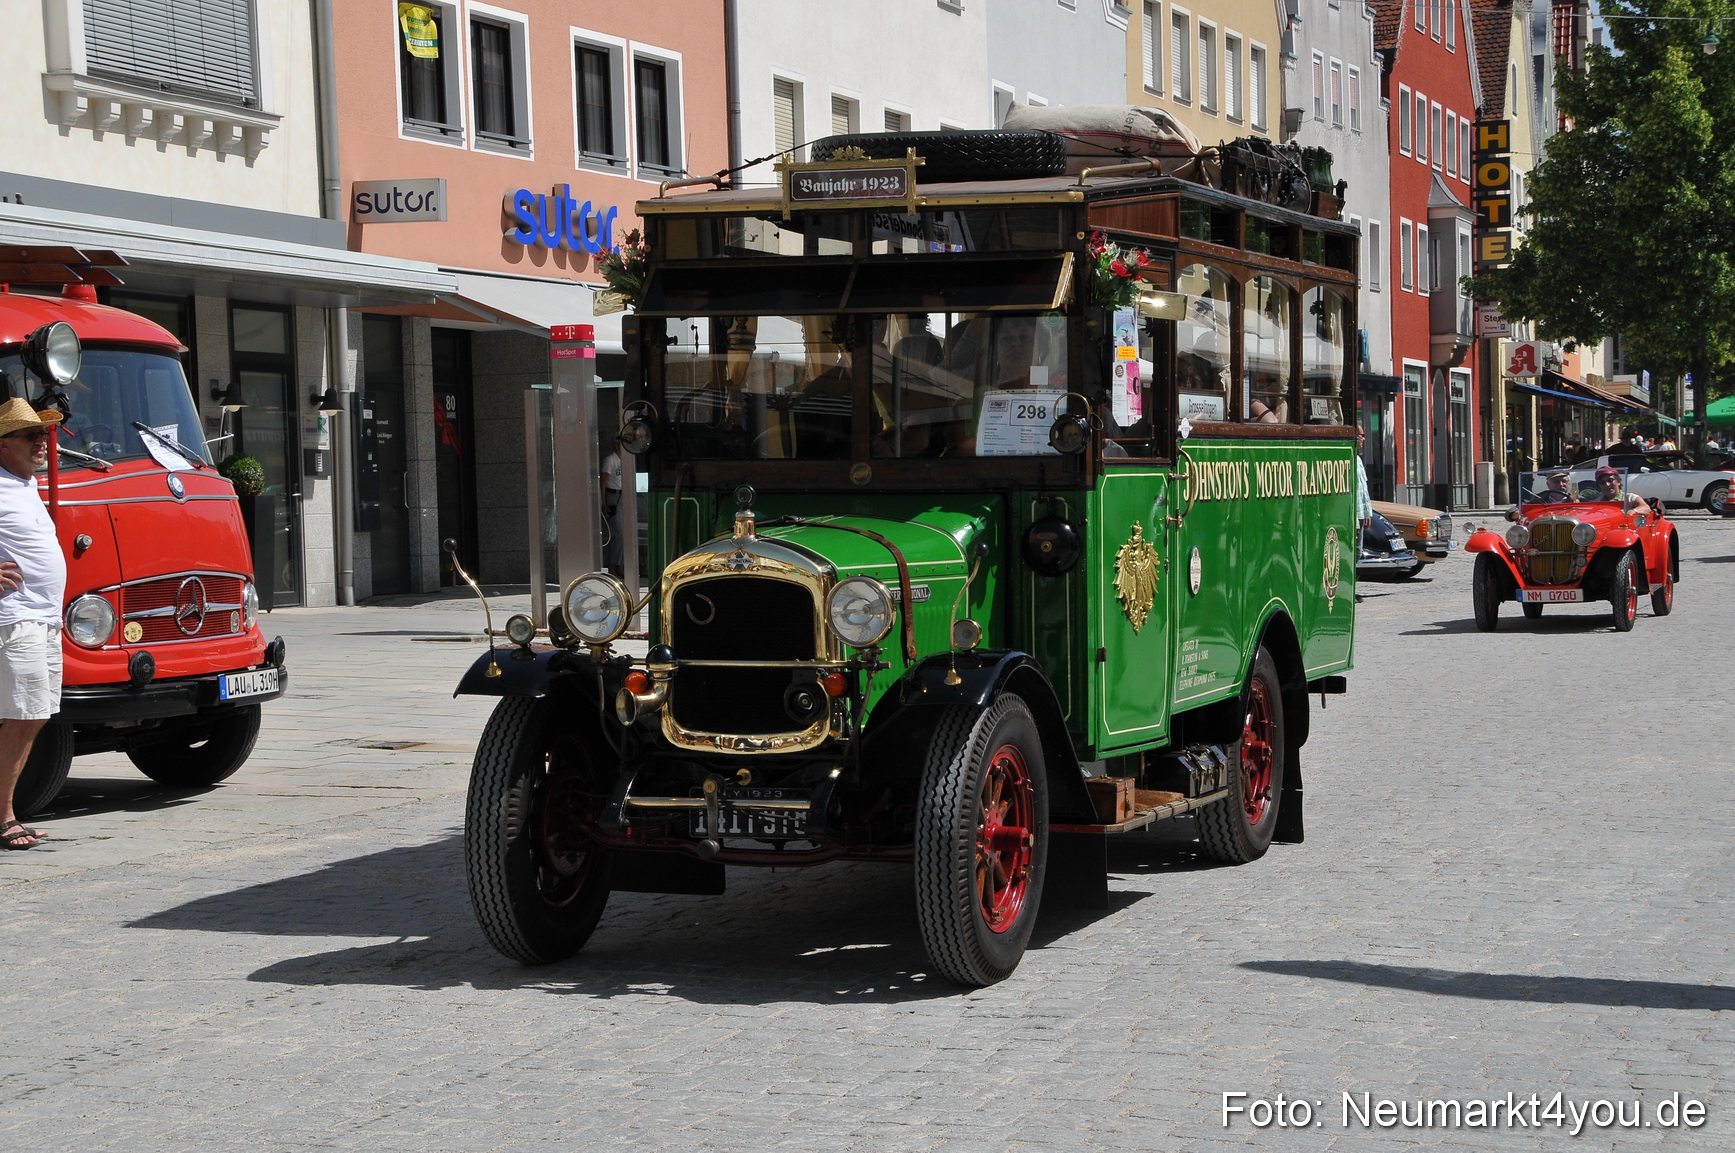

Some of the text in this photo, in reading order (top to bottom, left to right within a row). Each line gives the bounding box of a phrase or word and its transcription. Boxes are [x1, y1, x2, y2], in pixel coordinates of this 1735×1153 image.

[799, 175, 900, 196] Baujahr 1923
[356, 186, 437, 215] sutor.
[1478, 124, 1510, 281] HOTE
[556, 349, 577, 357] HotSpot
[445, 394, 456, 411] 80
[1016, 404, 1047, 420] 298
[1183, 459, 1351, 501] JOHNSTON'S MOTOR TRANSPORT
[1527, 590, 1577, 601] NM 0700
[227, 675, 247, 696] LAU
[251, 674, 259, 693] L
[259, 671, 279, 692] 319H
[747, 789, 783, 798] 1923
